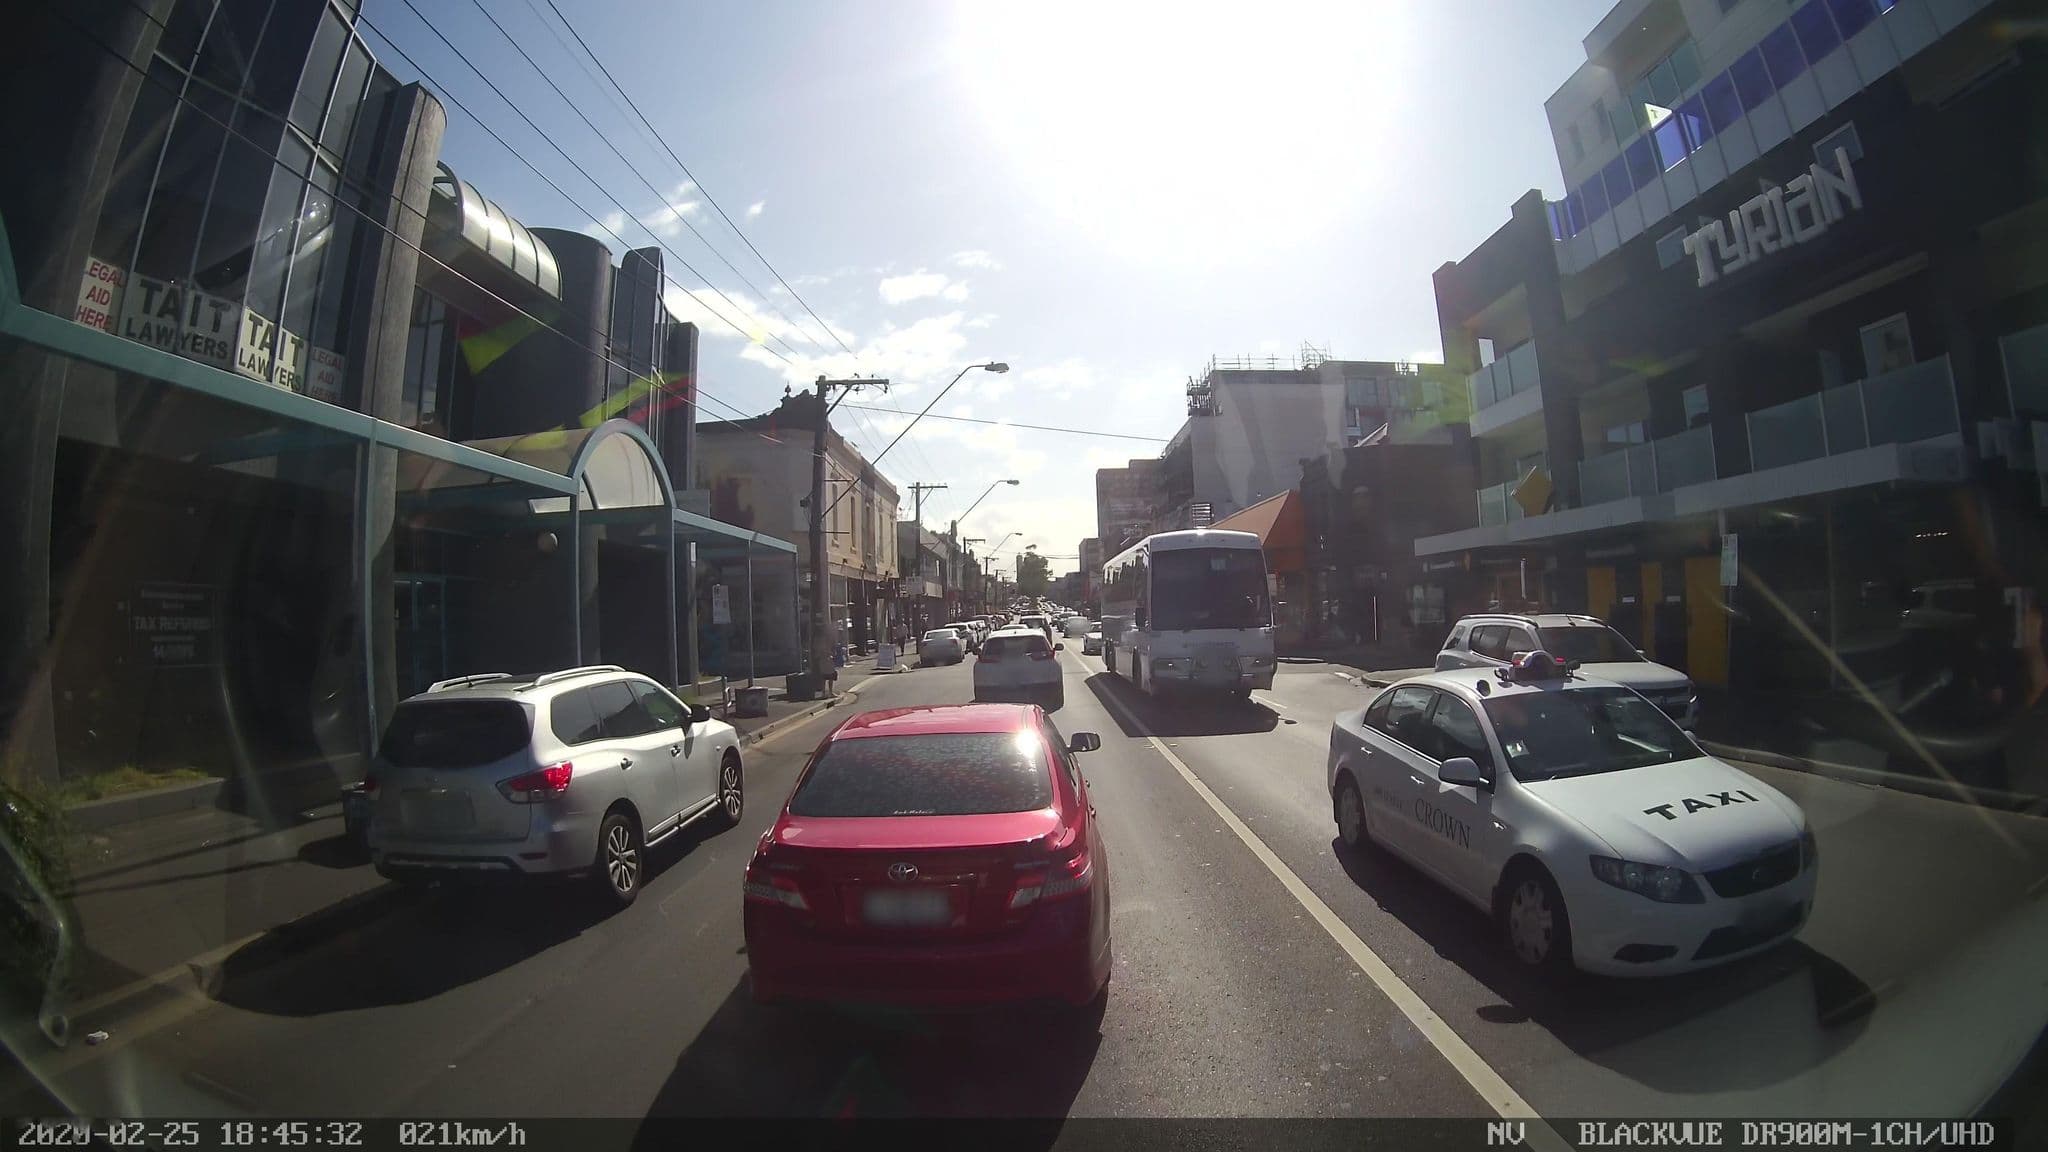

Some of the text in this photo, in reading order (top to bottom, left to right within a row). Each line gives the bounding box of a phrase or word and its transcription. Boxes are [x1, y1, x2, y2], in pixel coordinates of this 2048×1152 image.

[86, 285, 111, 306] AID
[139, 278, 232, 334] TAIT
[75, 305, 113, 332] HERE
[125, 316, 230, 360] LAWYERS
[248, 312, 305, 368] TAIT
[1415, 798, 1472, 849] CROWN
[1643, 789, 1760, 822] TAXI
